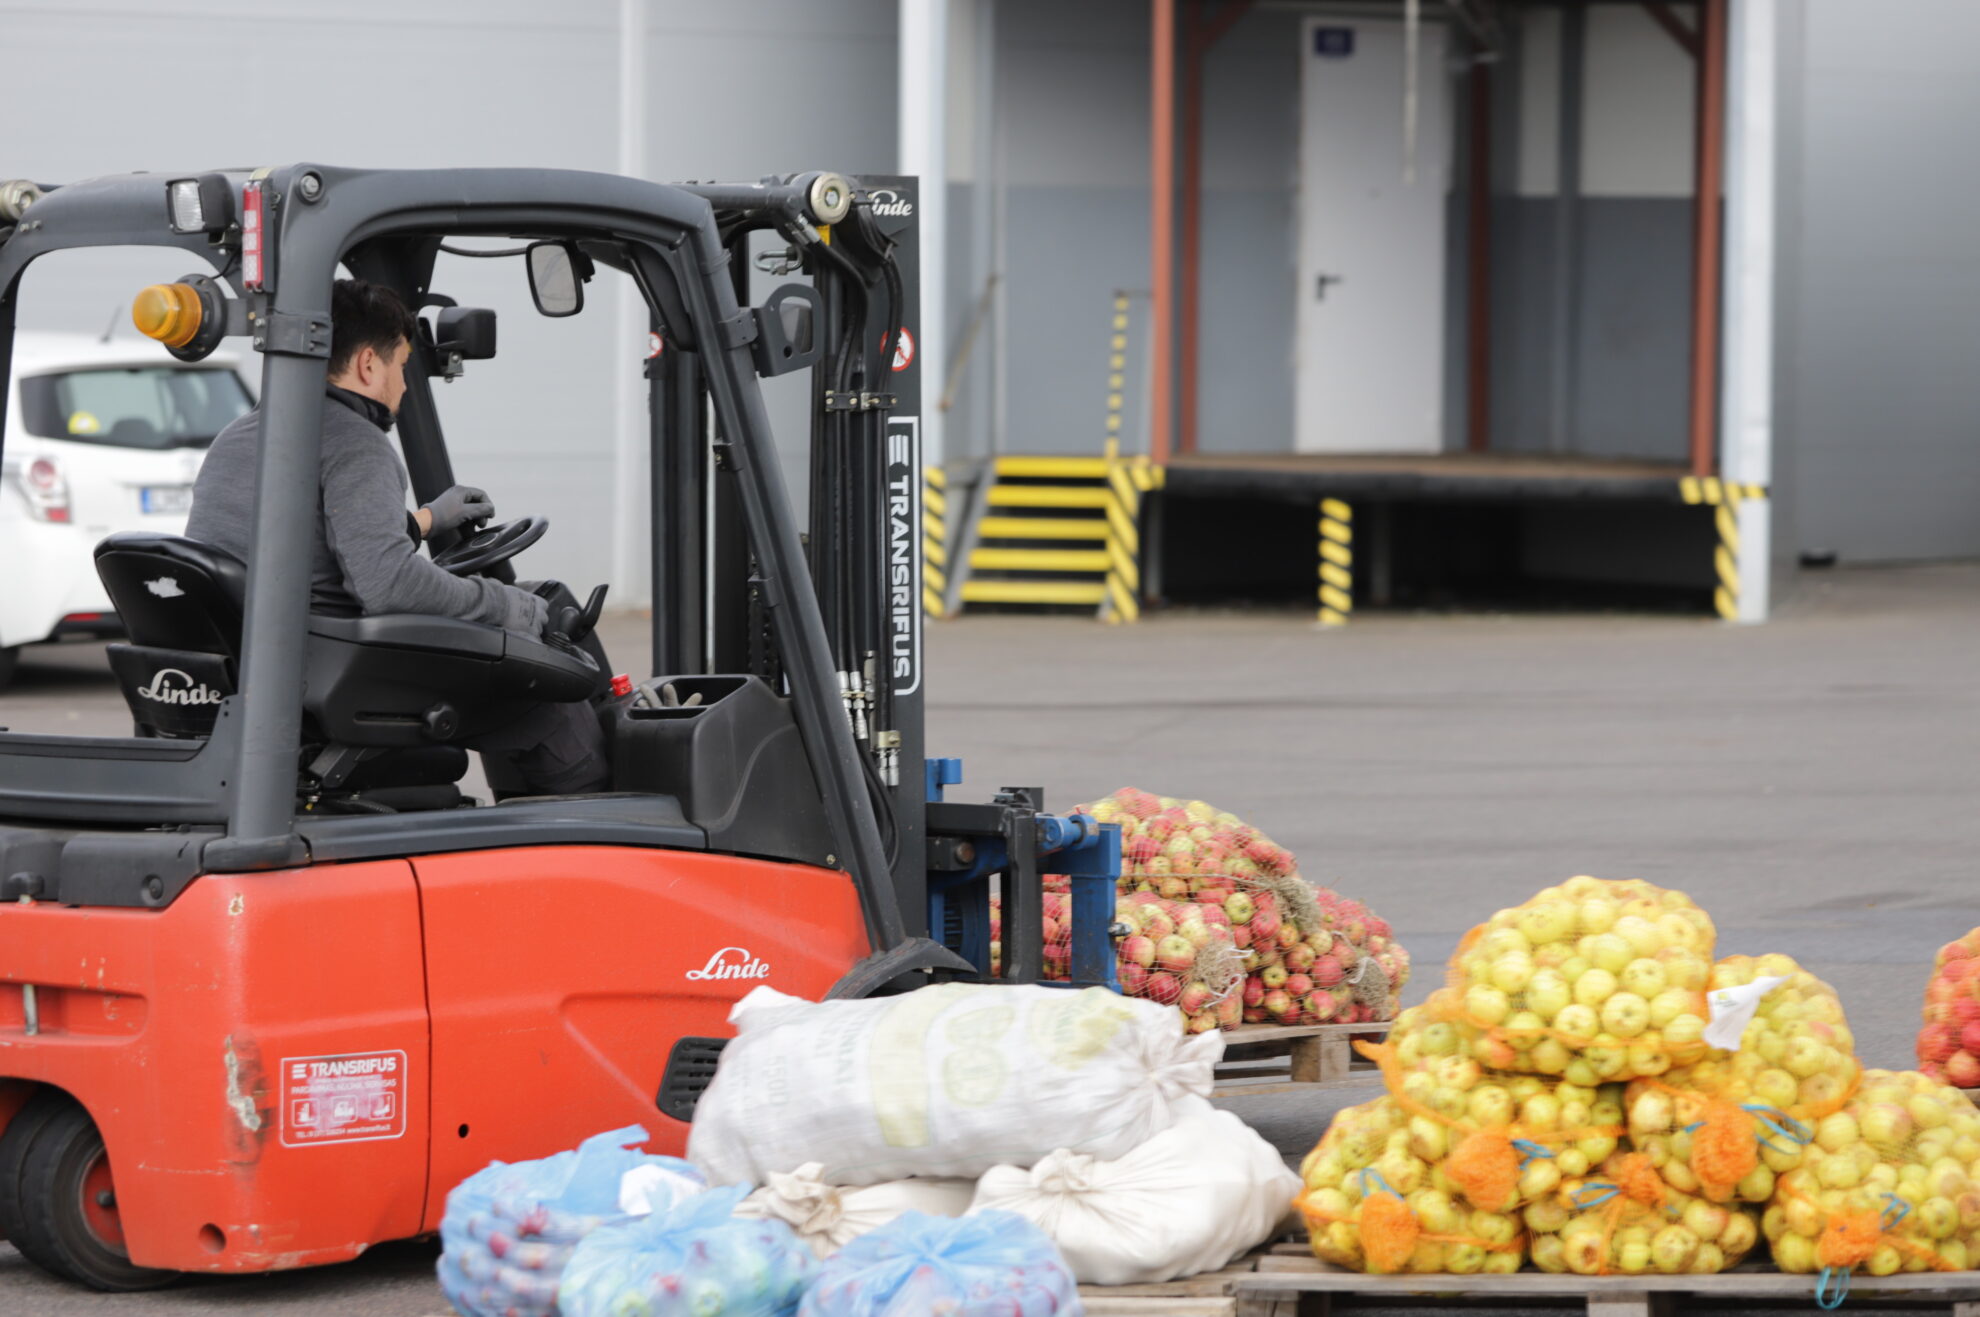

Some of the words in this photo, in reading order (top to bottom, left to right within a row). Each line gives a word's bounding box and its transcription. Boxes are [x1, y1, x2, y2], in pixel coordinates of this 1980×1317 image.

[889, 475, 911, 679] TRANSRIFUS
[137, 668, 224, 705] Linde
[685, 946, 770, 980] Linde
[309, 1057, 397, 1078] TRANSRIFUS
